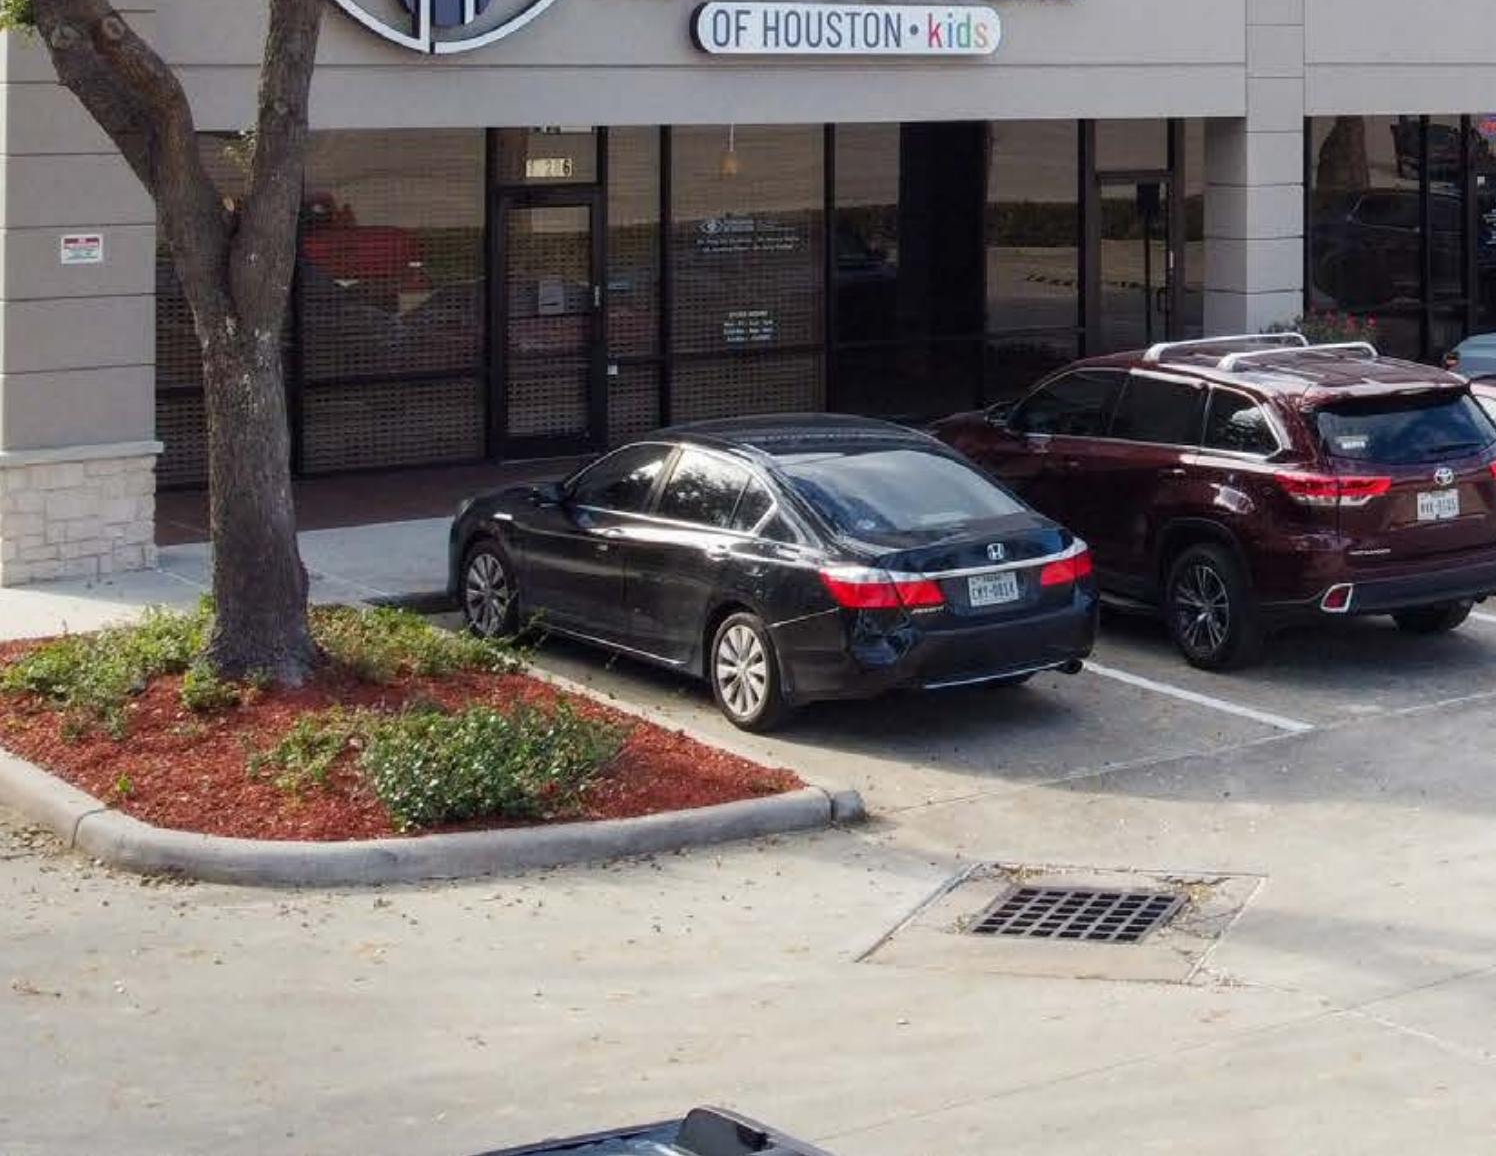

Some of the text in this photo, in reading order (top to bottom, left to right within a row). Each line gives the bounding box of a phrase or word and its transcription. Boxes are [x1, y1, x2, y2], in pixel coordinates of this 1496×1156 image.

[711, 9, 988, 48] OF HOUSTON kids
